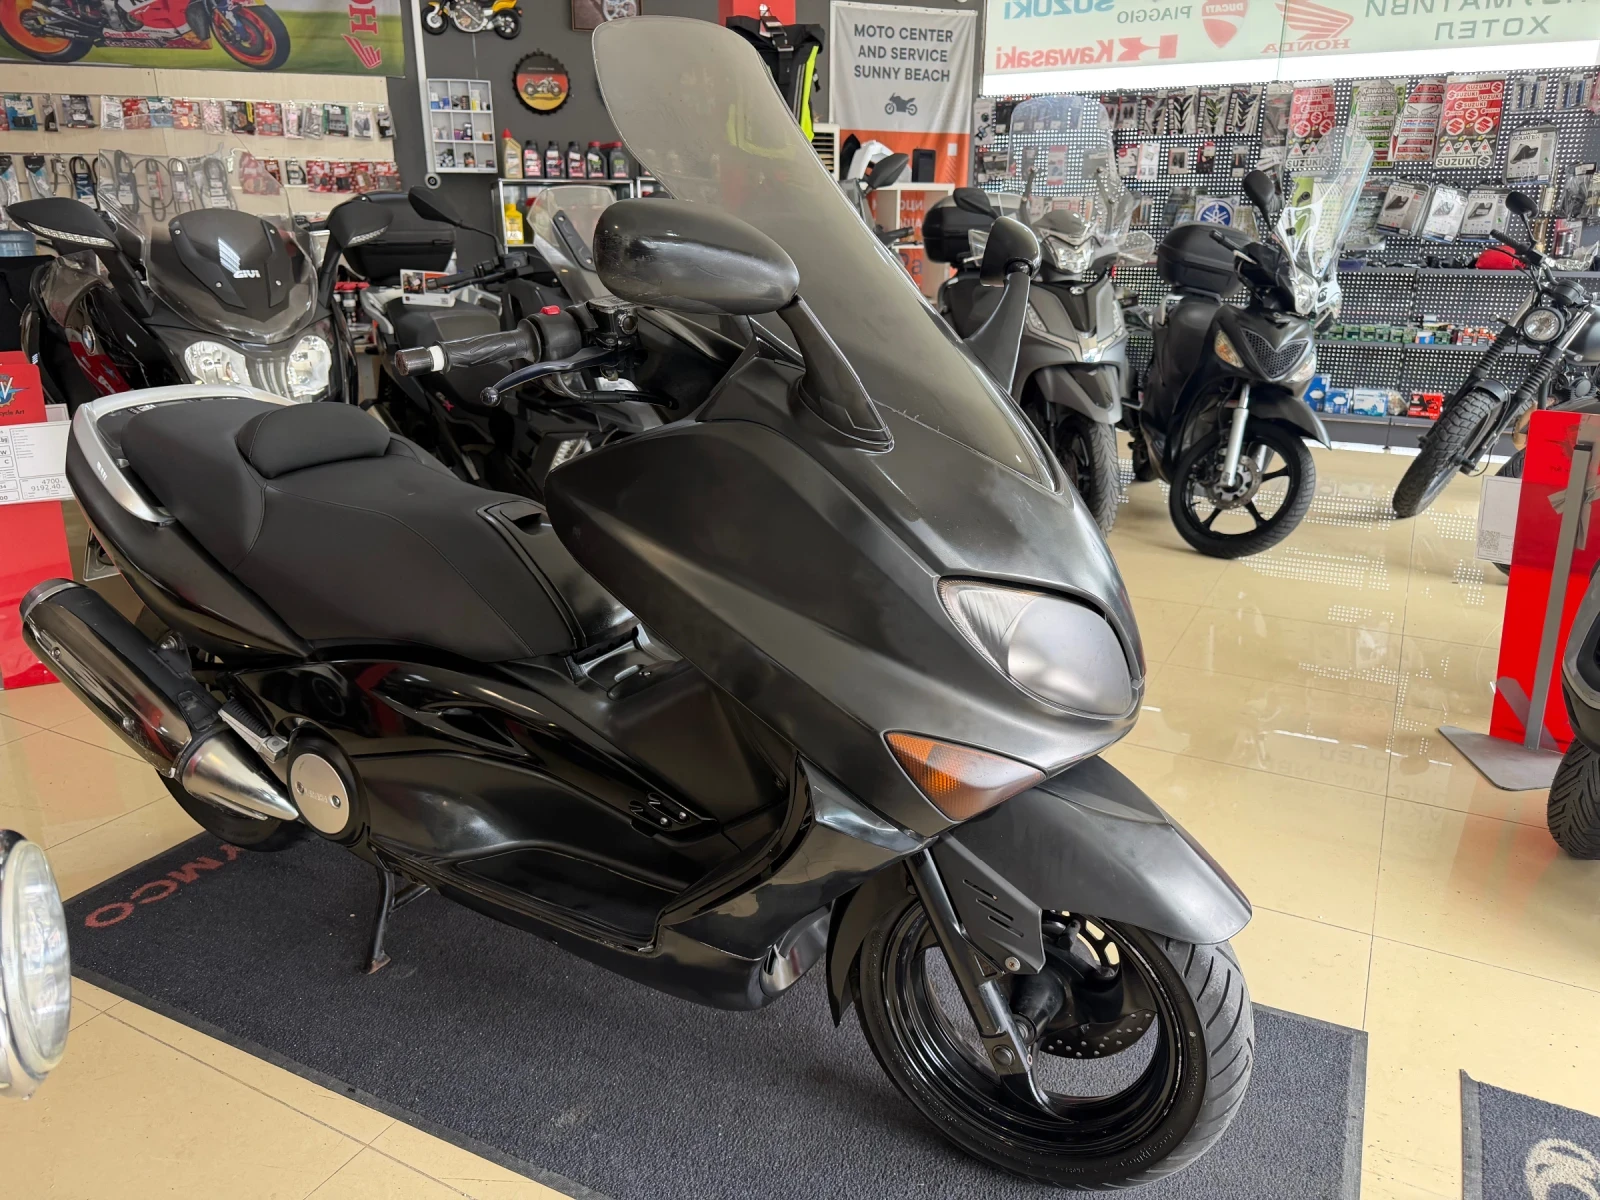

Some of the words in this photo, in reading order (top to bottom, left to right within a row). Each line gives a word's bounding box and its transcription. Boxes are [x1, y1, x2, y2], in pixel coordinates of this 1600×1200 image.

[854, 23, 895, 39] MOTO
[899, 27, 953, 42] CENTER
[858, 45, 887, 59] AND
[890, 47, 948, 62] SERVICE
[854, 65, 901, 80] SUNNY
[904, 67, 950, 82] BEACH
[1286, 159, 1321, 168] SUZUKI
[1436, 157, 1477, 167] SUZUKI
[233, 270, 261, 278] GIVI
